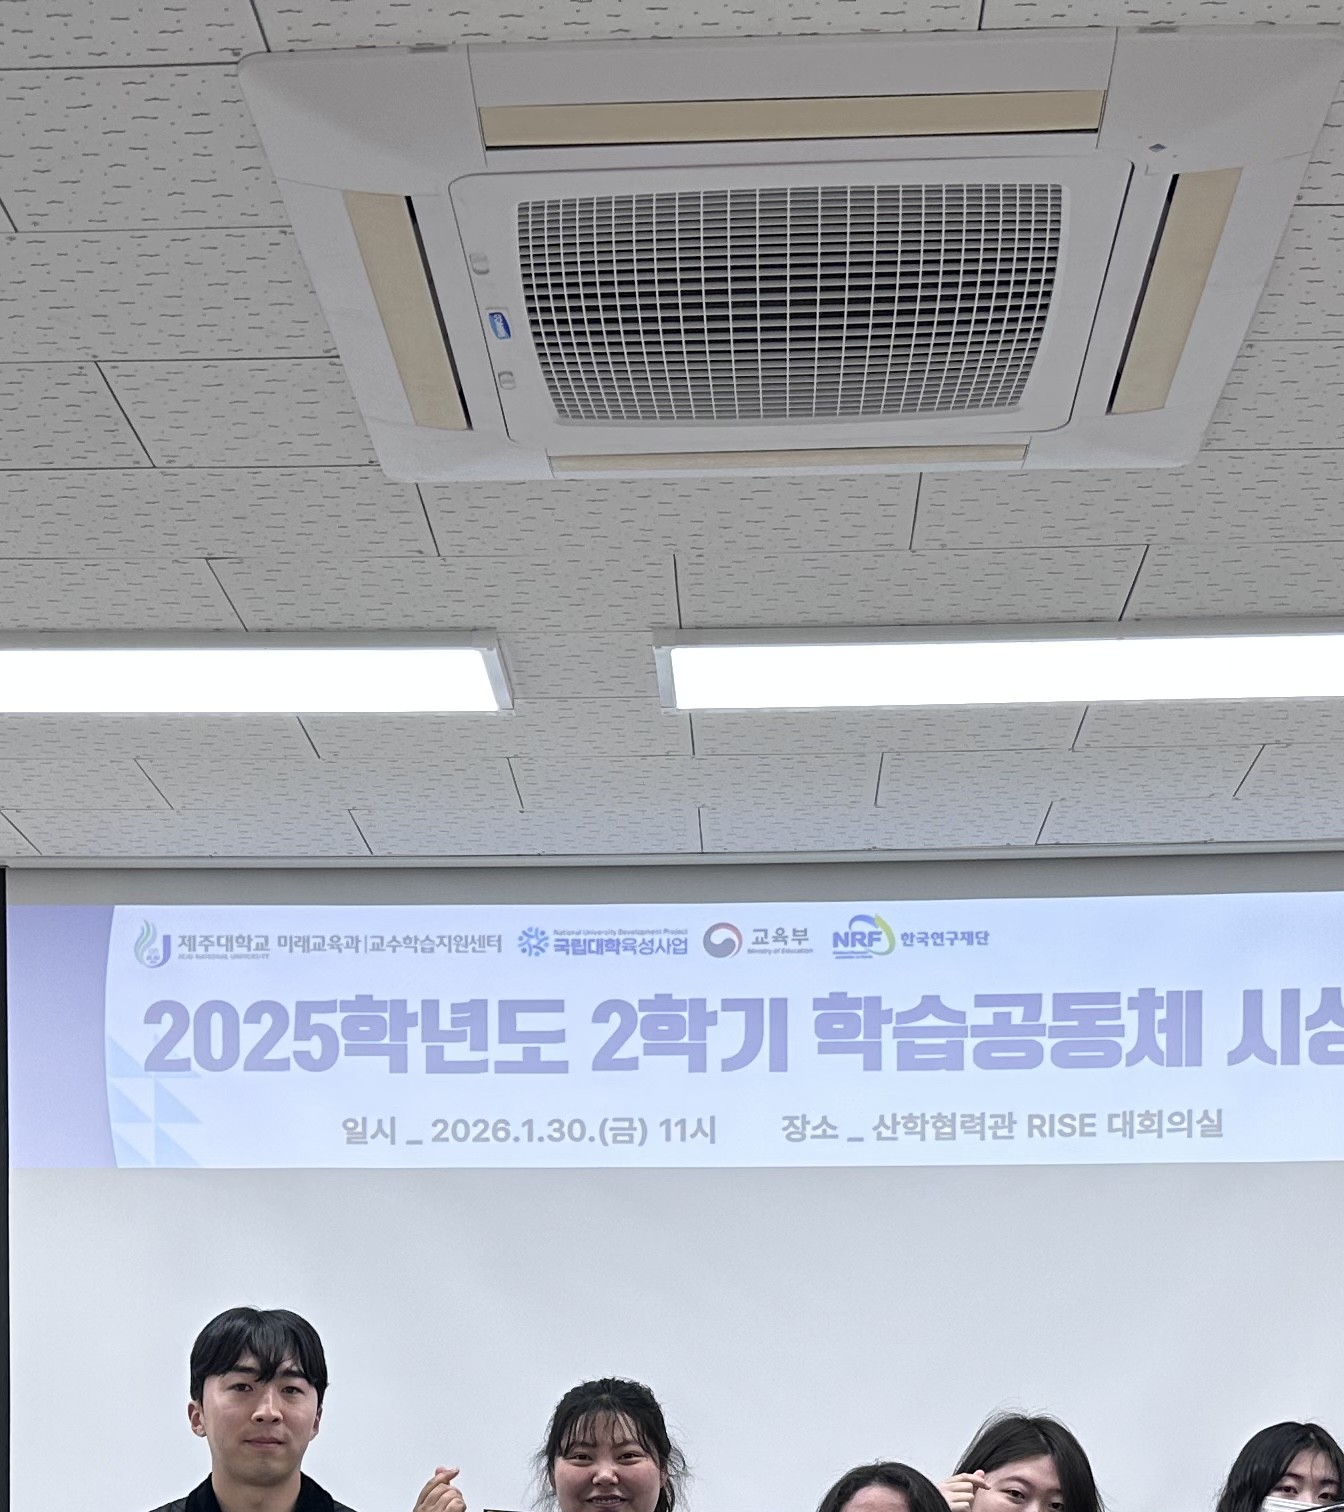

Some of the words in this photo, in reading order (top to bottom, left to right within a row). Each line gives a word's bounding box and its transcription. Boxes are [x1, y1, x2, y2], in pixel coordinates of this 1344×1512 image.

[178, 934, 270, 952] 제주대학교
[277, 934, 360, 953] 미래교육과
[370, 934, 502, 953] 교수학습지원센터
[751, 927, 809, 946] 교육부
[832, 931, 883, 948] NRF
[900, 930, 990, 948] 한국연구재단
[553, 937, 688, 956] 국립대학육성사업
[142, 993, 570, 1074] 2025학년도
[590, 993, 789, 1073] 2학기
[812, 987, 1202, 1073] 학습공동체
[341, 1115, 398, 1146] 일시
[431, 1115, 648, 1146] 2026.1.30.(금)
[659, 1115, 718, 1145] 11시
[780, 1113, 839, 1143] 장소
[871, 1110, 1018, 1143] 산학협력관
[1027, 1112, 1098, 1139] RISE
[1107, 1108, 1224, 1141] 대회의실
